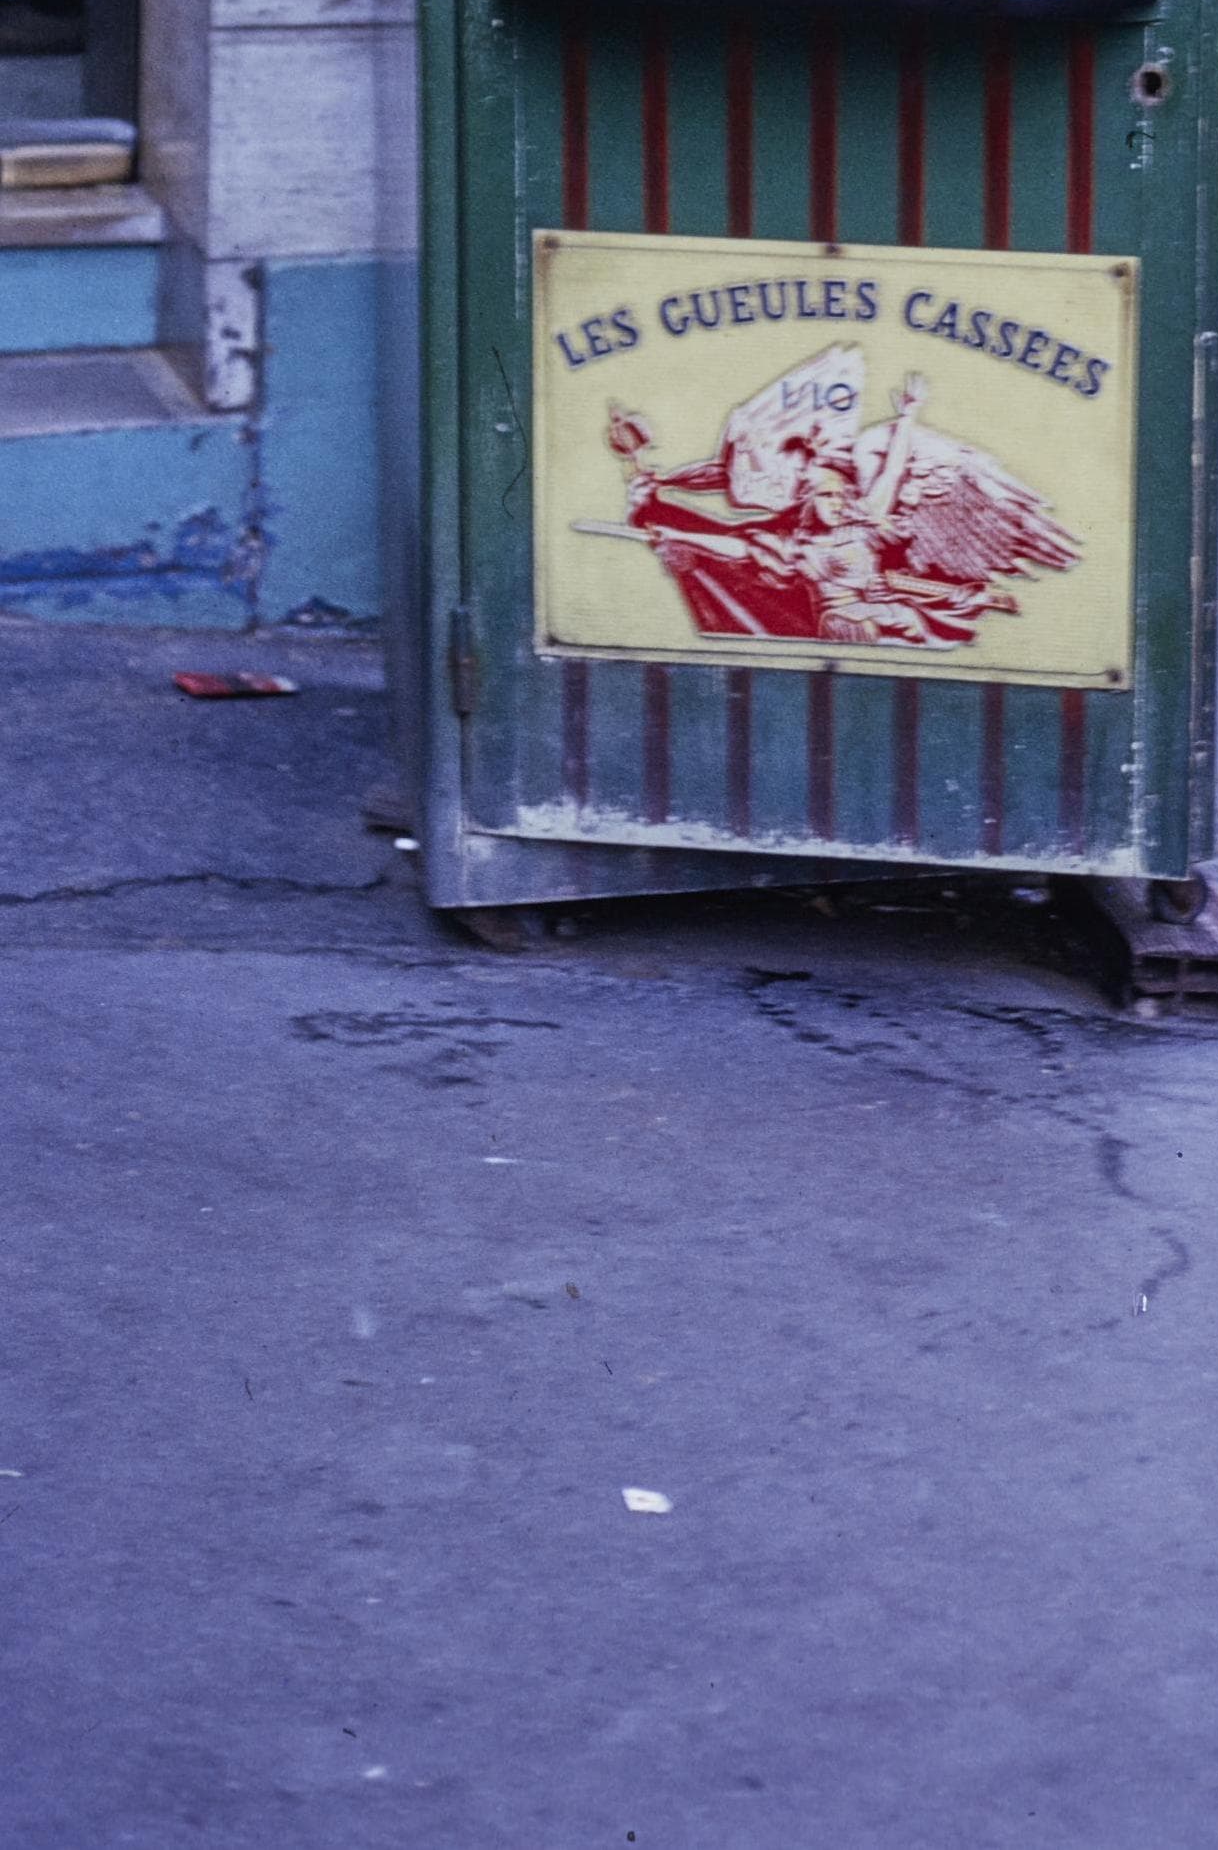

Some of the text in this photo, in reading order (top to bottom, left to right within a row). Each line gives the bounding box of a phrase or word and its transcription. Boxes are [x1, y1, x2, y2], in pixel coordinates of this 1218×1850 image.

[556, 309, 641, 369] LES
[659, 280, 879, 338] GUEULES
[903, 291, 1111, 399] CASSEES
